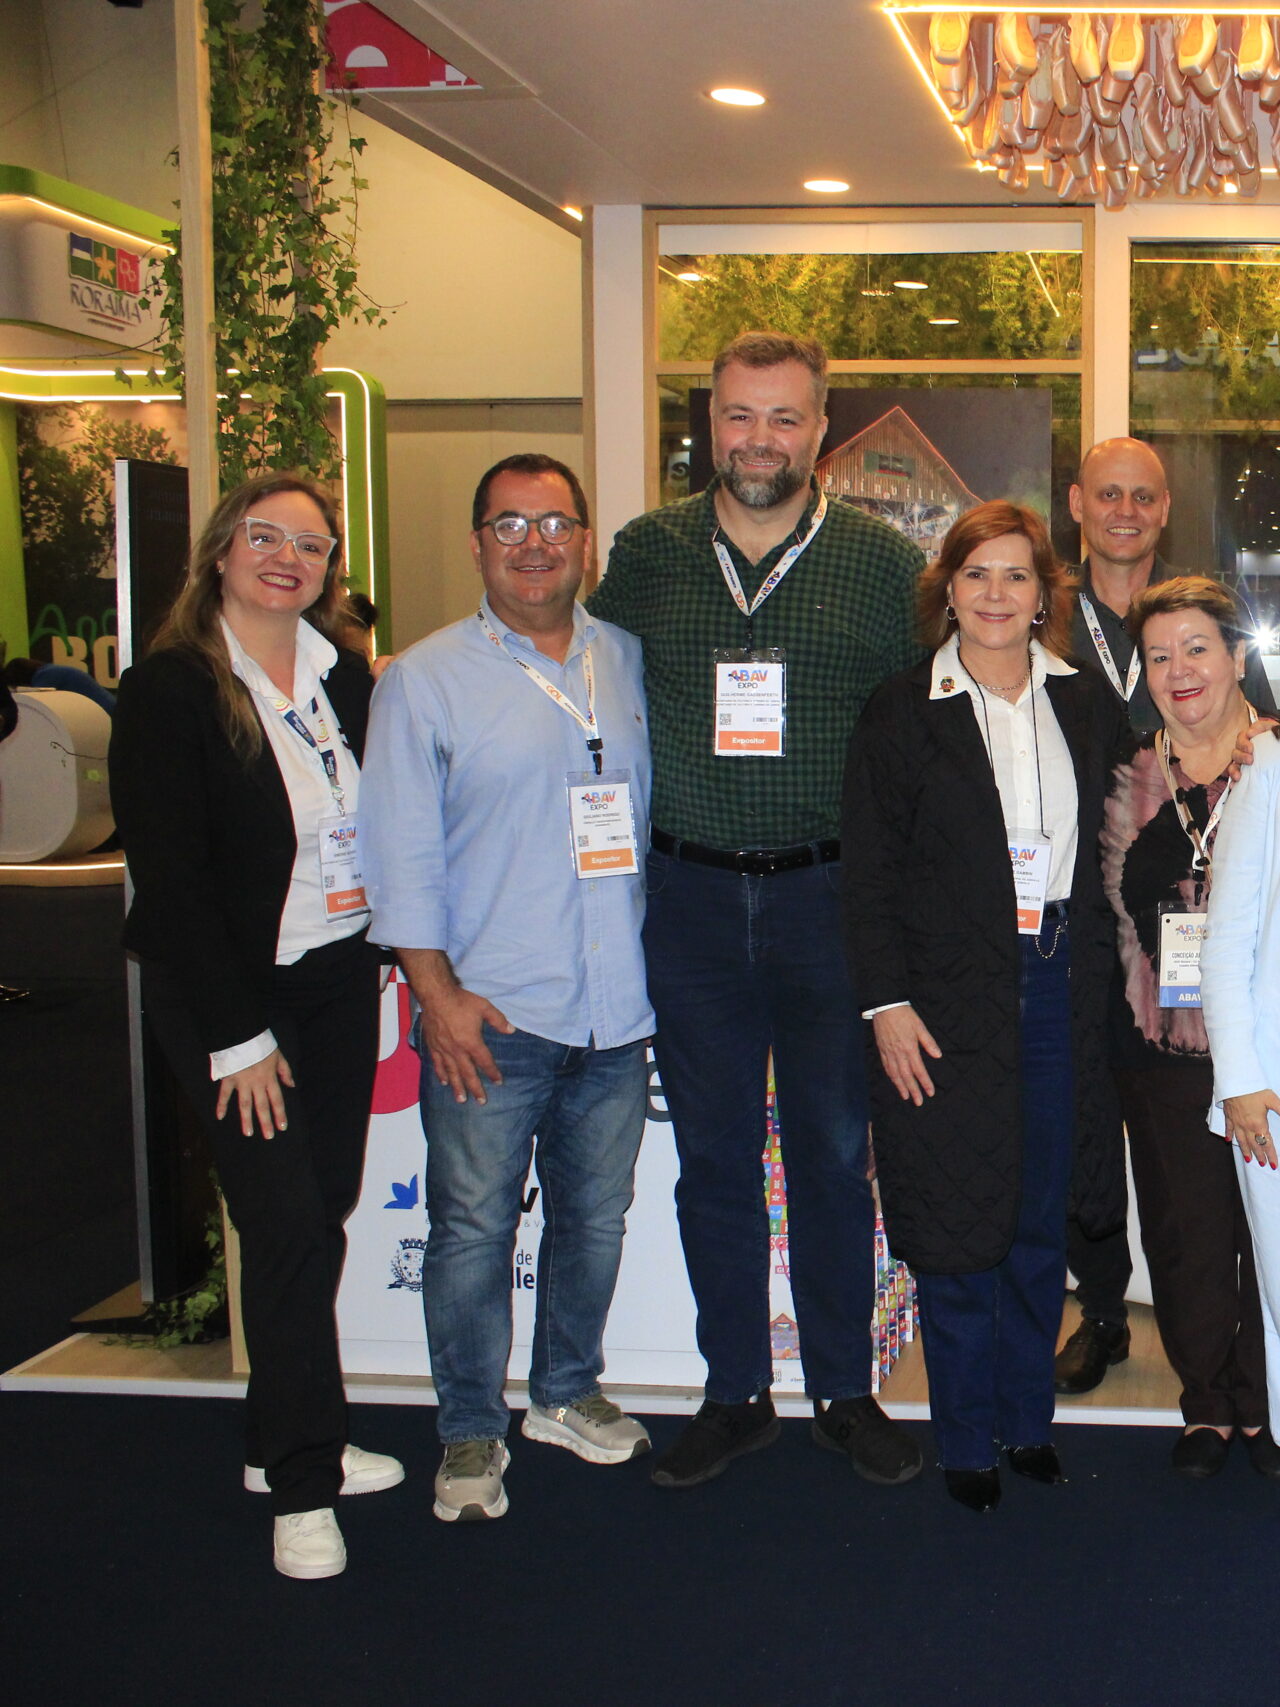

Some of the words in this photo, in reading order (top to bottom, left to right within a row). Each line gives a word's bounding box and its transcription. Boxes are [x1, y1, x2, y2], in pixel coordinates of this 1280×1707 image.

[70, 283, 141, 323] RORAIMA
[728, 669, 768, 682] ABAV
[732, 737, 766, 746] Expositor
[581, 791, 617, 804] ABAV
[590, 803, 608, 811] EXPO
[592, 856, 621, 864] Expositor
[1008, 847, 1037, 861] BAV
[516, 1249, 533, 1266] de
